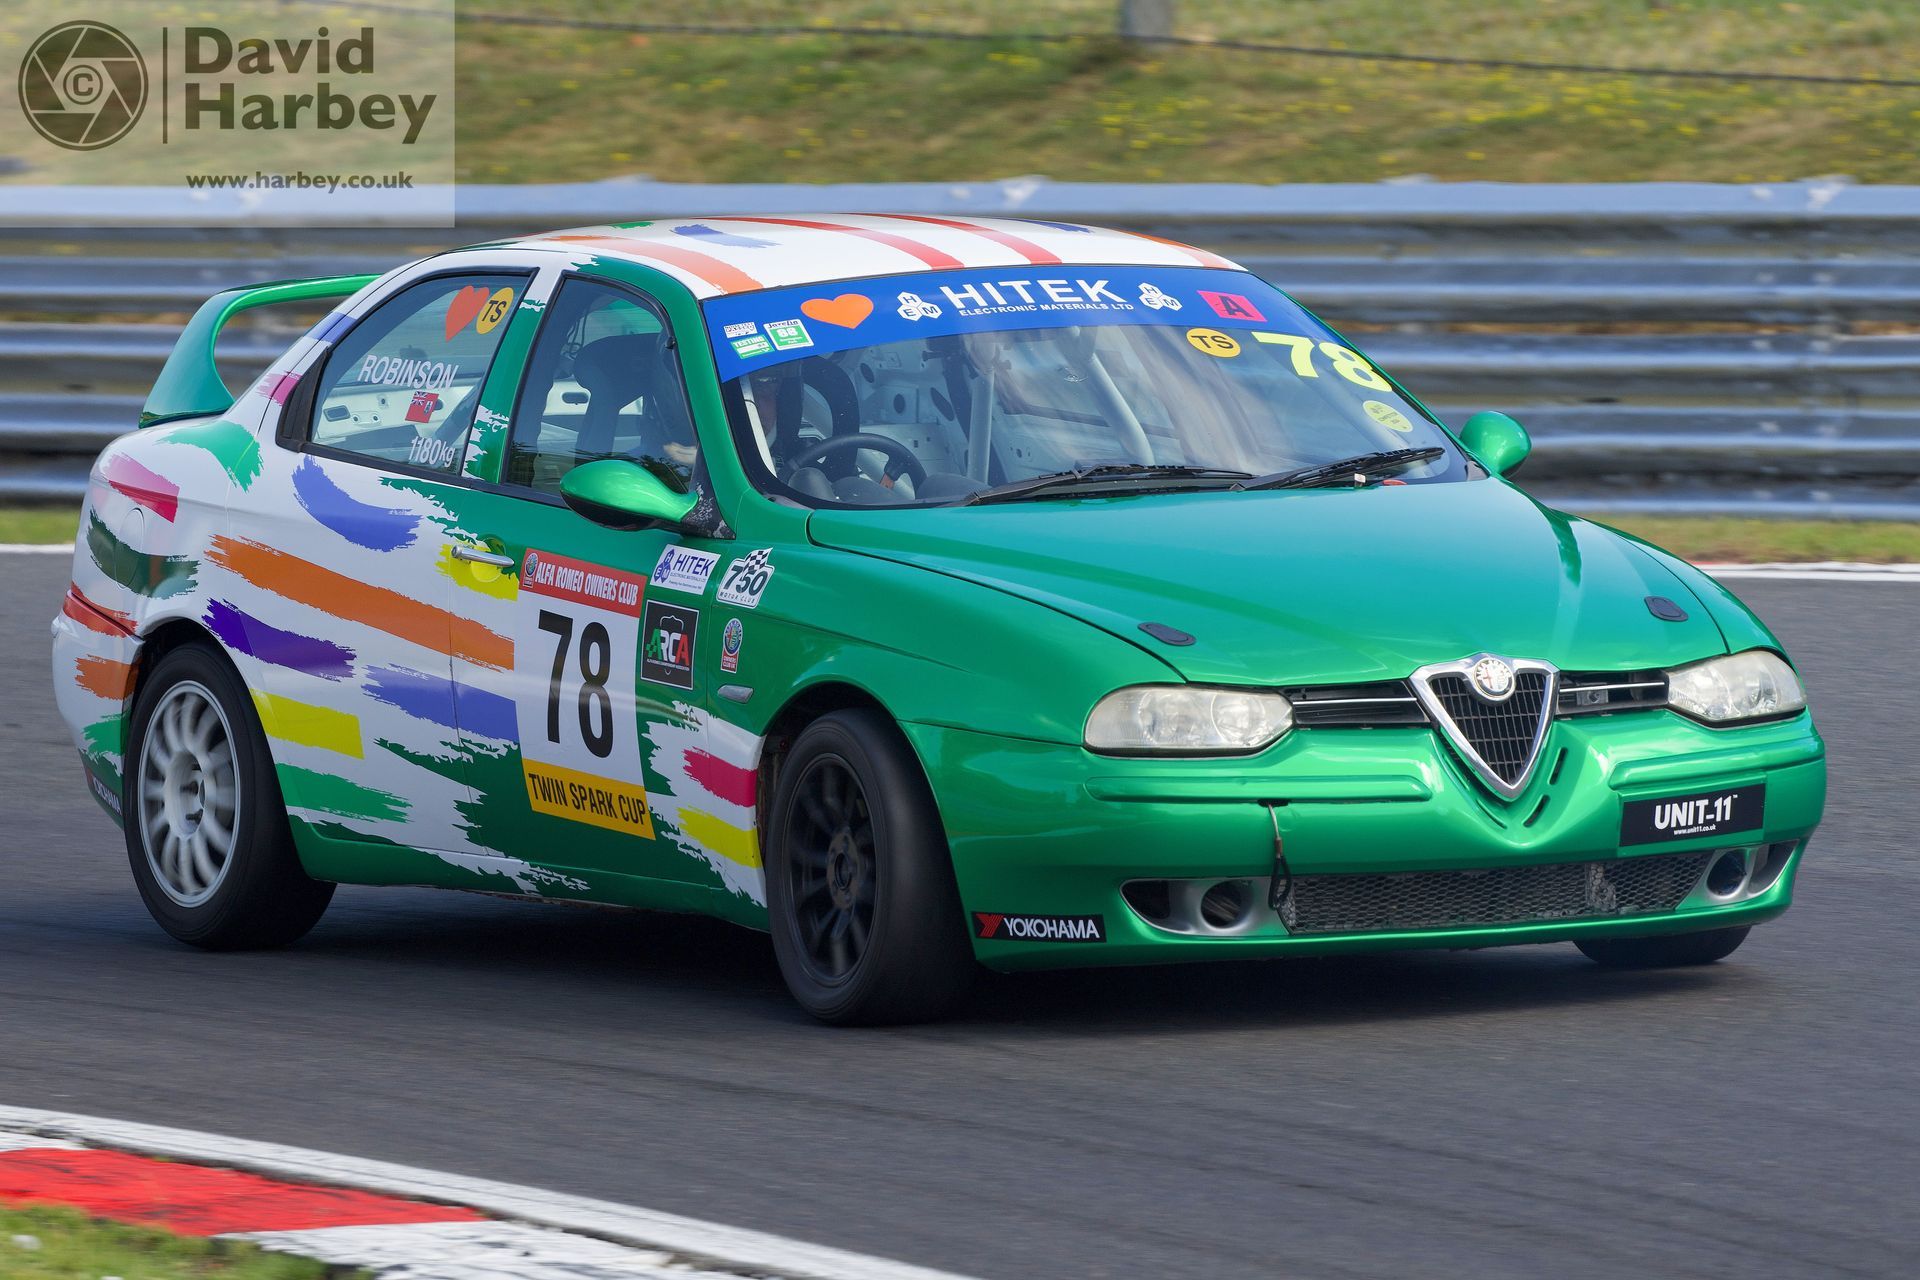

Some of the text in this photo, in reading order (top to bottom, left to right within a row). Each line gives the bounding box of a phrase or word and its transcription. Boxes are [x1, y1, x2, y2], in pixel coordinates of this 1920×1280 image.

[939, 279, 1127, 309] HITEK
[959, 304, 1037, 317] ELECTRONIC
[1040, 303, 1108, 311] MATERIALS
[1217, 295, 1254, 318] A
[481, 299, 507, 323] TS
[1190, 335, 1235, 350] TS
[357, 354, 459, 390] ROBINSON
[1251, 331, 1393, 392] 78
[408, 435, 456, 467] 1180kg
[672, 553, 715, 577] HITEK
[723, 564, 769, 596] 750
[535, 561, 556, 586] ALFA
[555, 566, 585, 593] ROMEO
[584, 573, 618, 601] OWNERS
[618, 581, 639, 606] CLUB
[646, 628, 690, 666] ARCA
[538, 608, 614, 759] 78
[528, 773, 646, 825] TWIN SPARK CUP
[1003, 917, 1100, 939] YOKOHAMA
